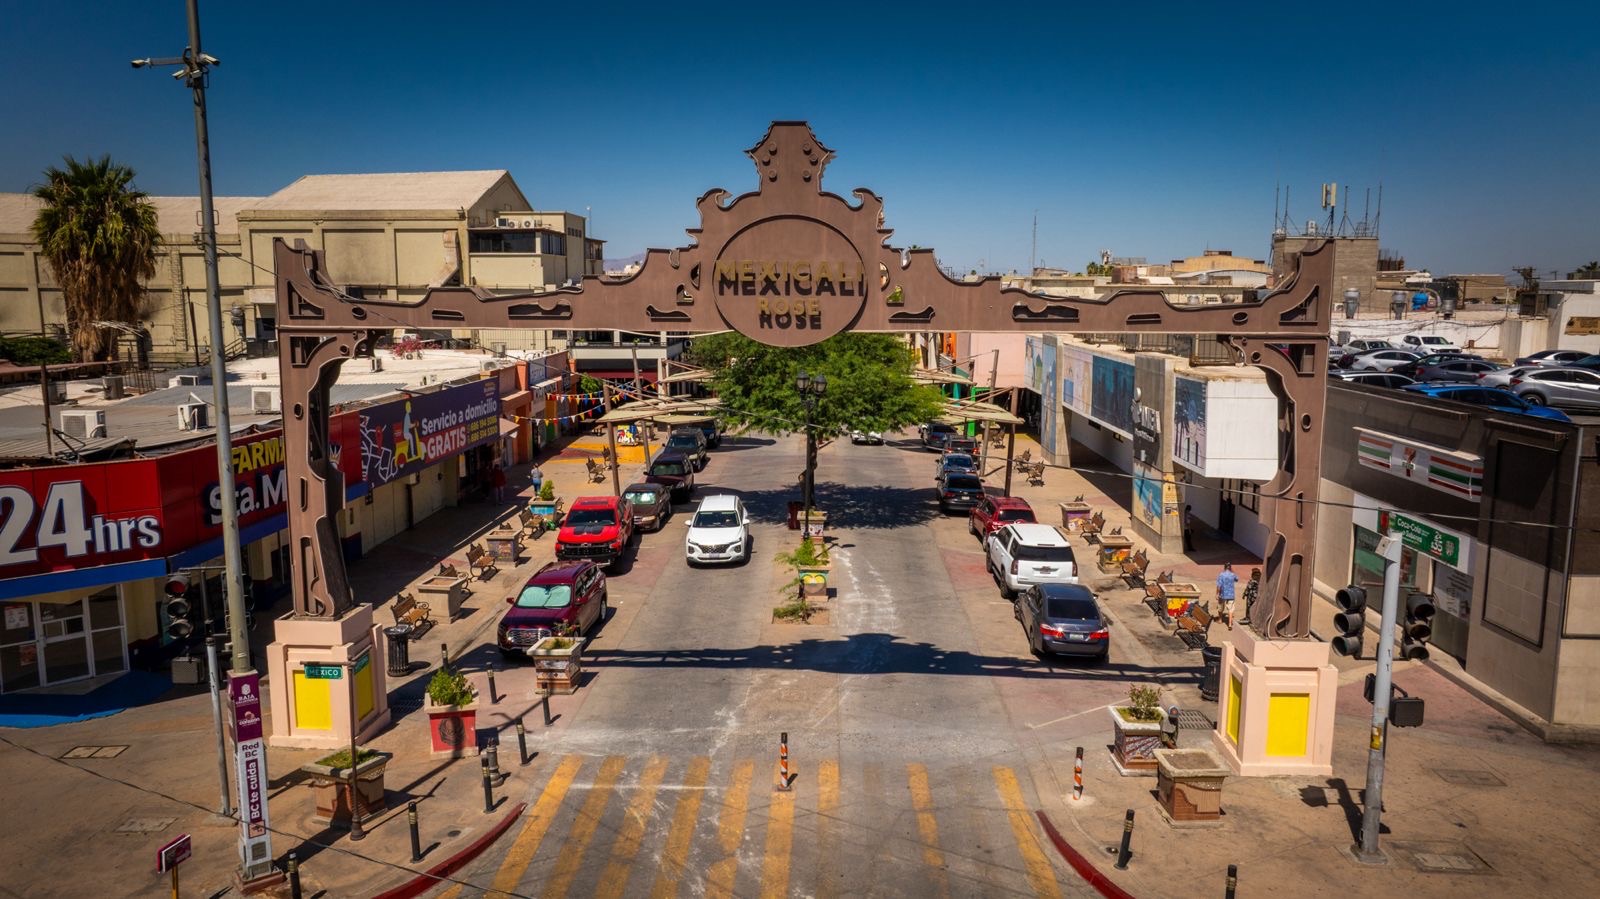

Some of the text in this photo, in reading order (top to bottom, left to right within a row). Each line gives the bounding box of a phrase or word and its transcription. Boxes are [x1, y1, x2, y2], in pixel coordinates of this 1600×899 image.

[714, 260, 864, 282] MEXICALI
[757, 298, 820, 316] ROSE
[421, 398, 497, 436] Servicio a domicilio
[427, 425, 467, 459] GRATIS
[241, 742, 259, 751] Red
[245, 749, 258, 758] BC
[247, 761, 260, 819] BC te cuida
